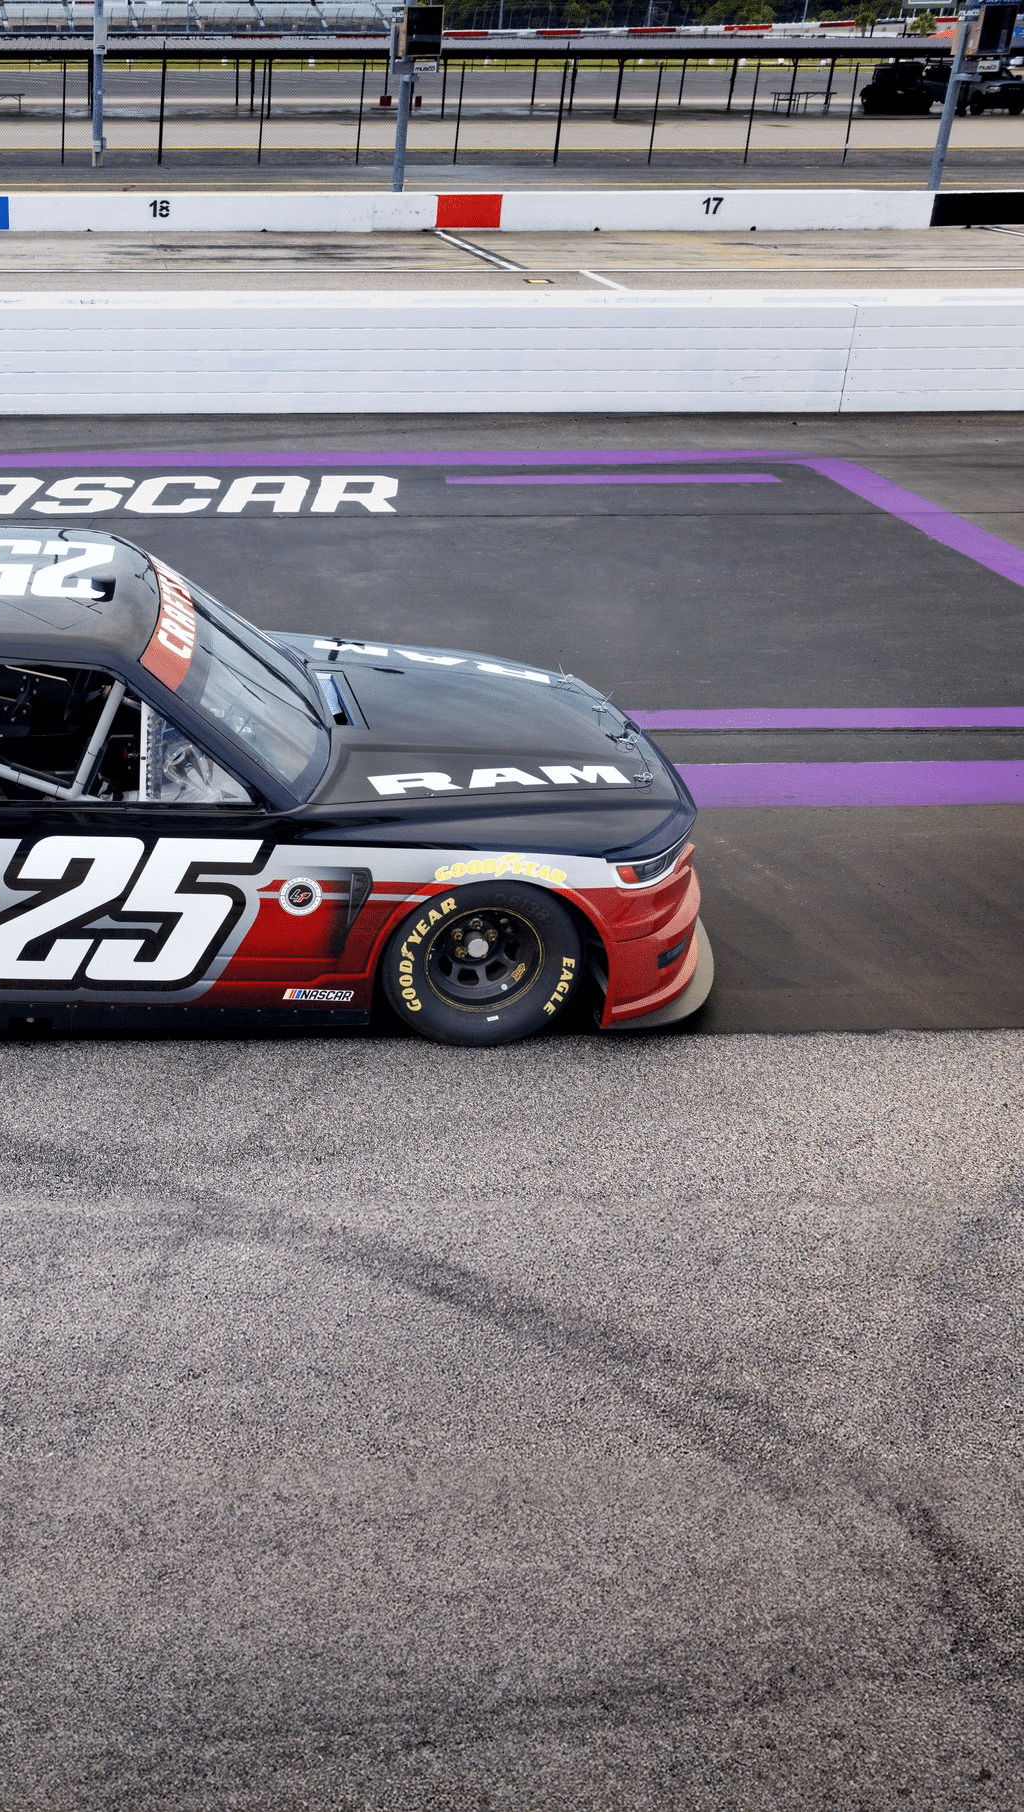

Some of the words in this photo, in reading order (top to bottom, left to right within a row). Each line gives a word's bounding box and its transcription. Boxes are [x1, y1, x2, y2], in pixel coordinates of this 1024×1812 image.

[149, 200, 170, 217] 18
[702, 197, 724, 215] 17
[366, 765, 631, 796] RAM
[434, 854, 568, 884] GOODYEAR
[399, 897, 458, 1013] GOODYEAR
[300, 990, 353, 1001] NASCAR
[543, 956, 576, 1016] EAGLE
